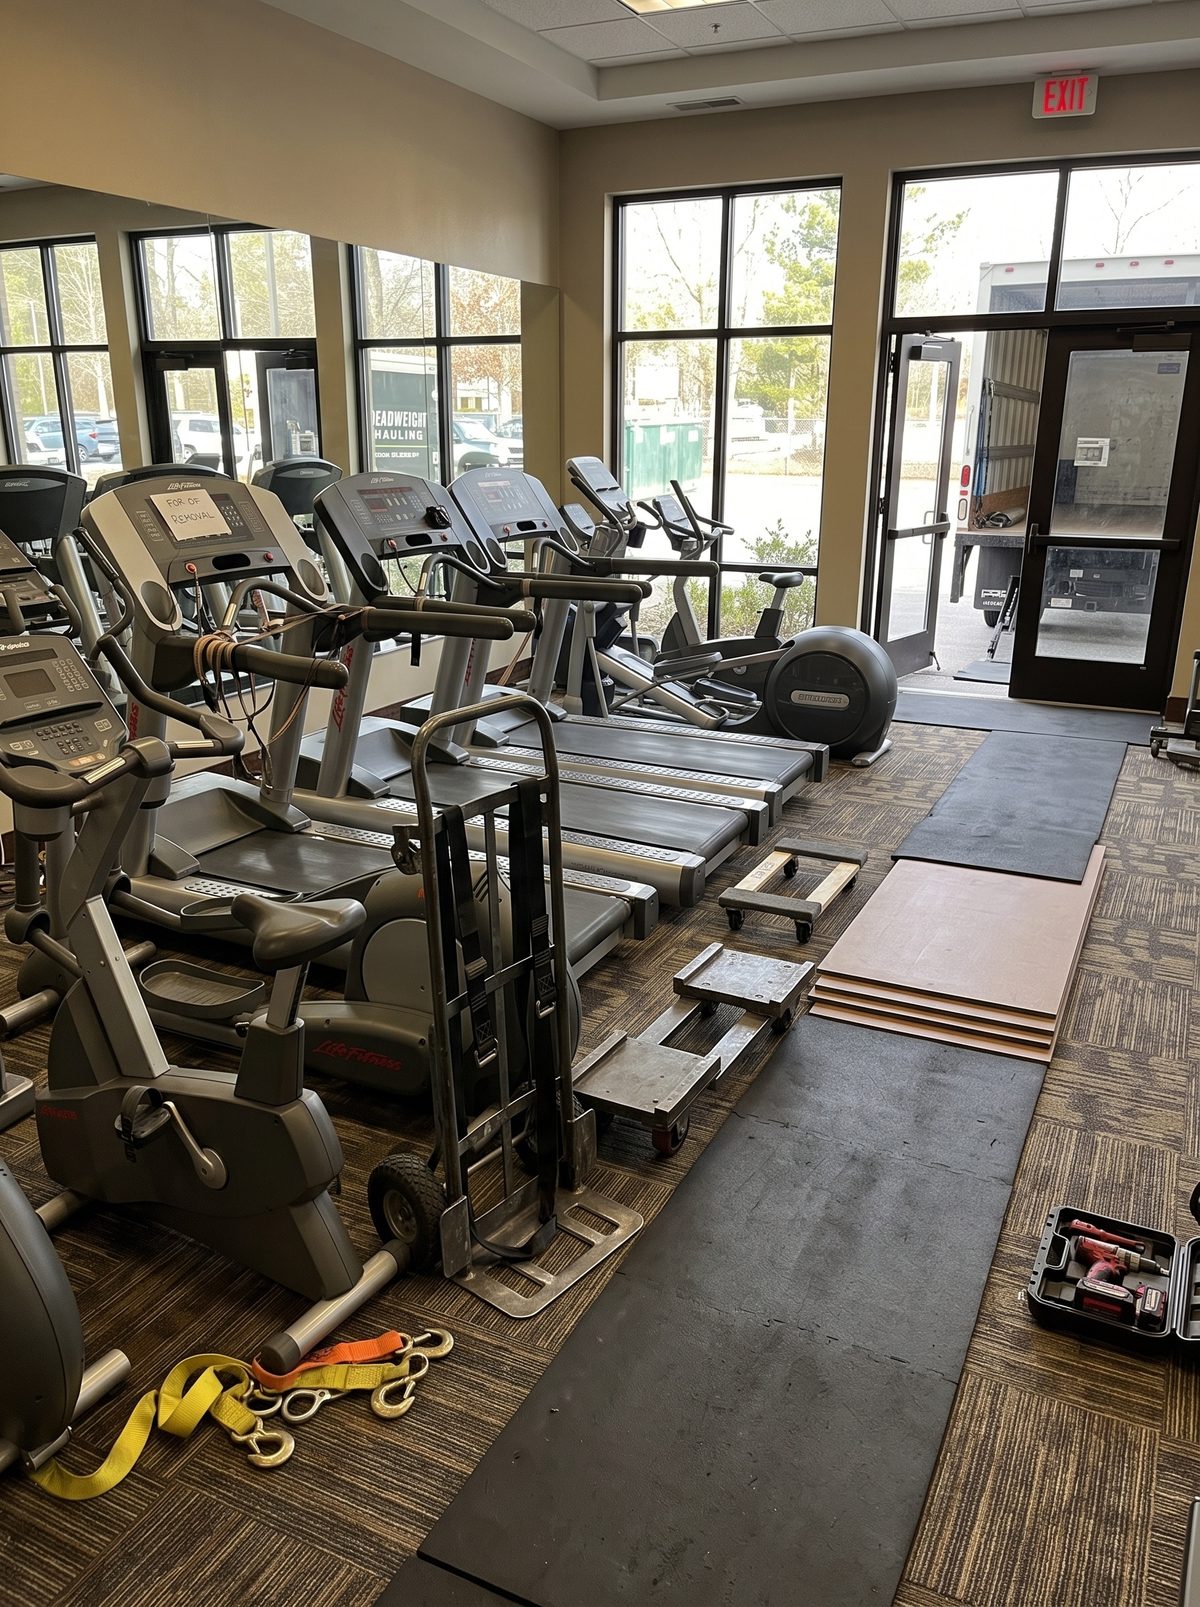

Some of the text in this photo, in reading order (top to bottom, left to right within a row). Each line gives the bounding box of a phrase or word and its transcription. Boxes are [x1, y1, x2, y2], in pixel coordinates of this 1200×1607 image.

[1044, 77, 1088, 112] EXIT
[374, 429, 423, 440] HAULING
[166, 498, 185, 507] FOR
